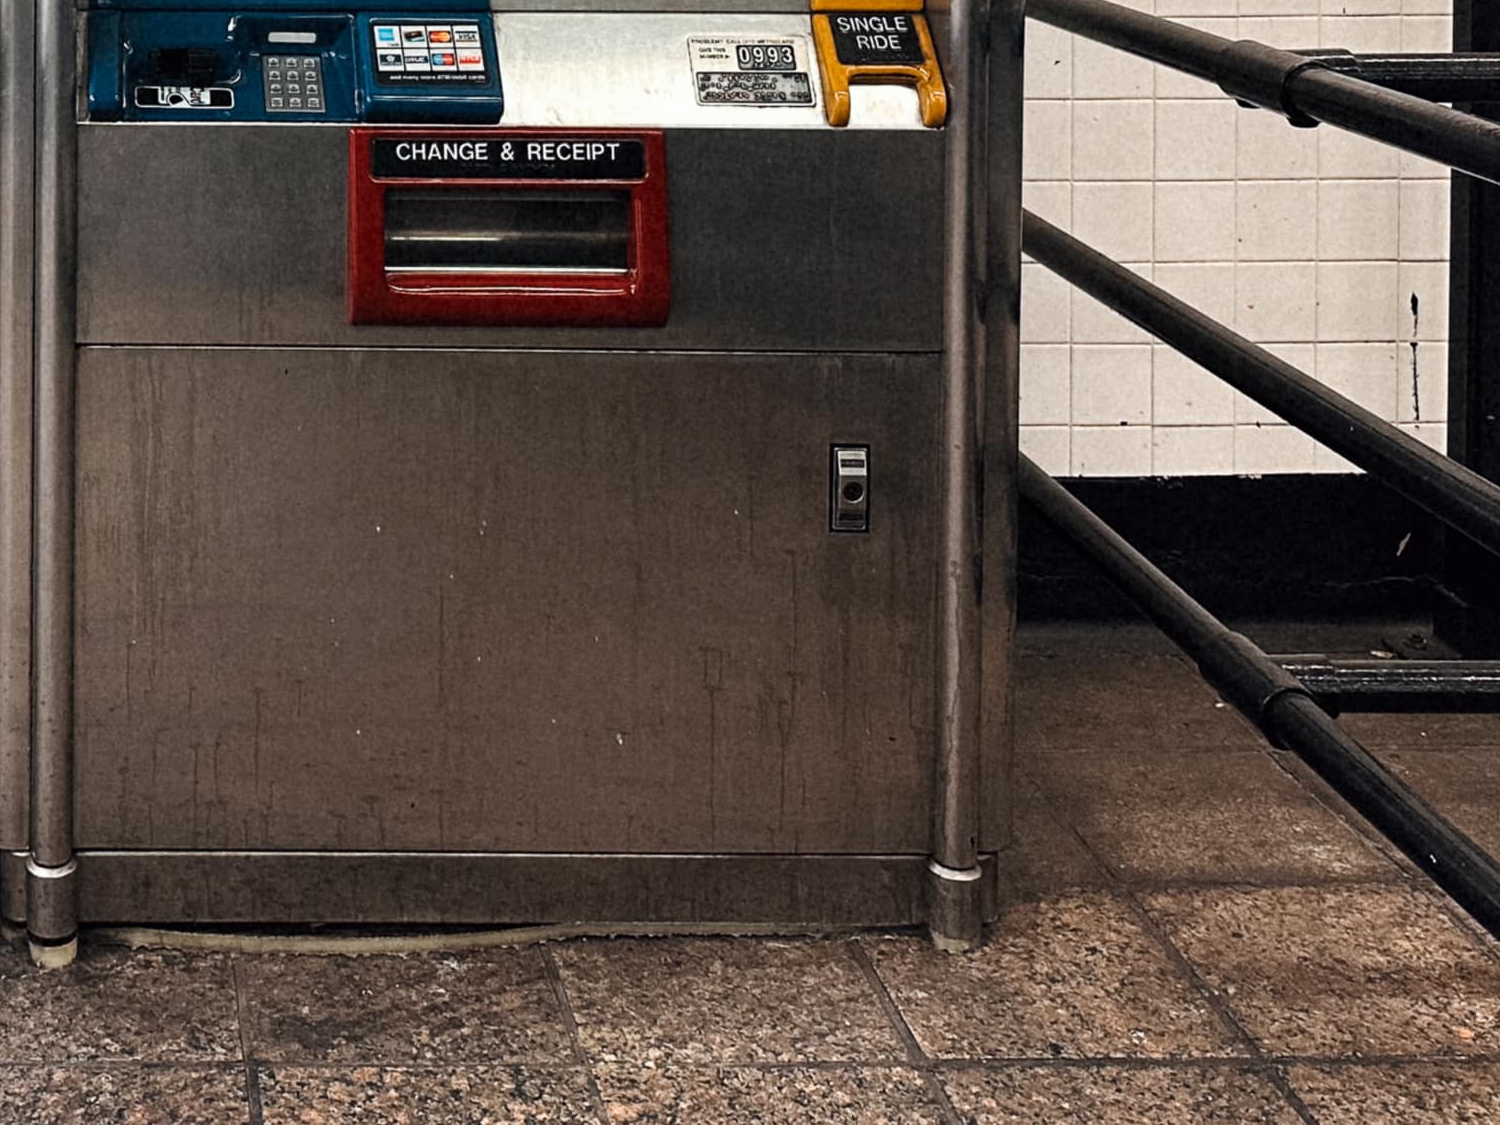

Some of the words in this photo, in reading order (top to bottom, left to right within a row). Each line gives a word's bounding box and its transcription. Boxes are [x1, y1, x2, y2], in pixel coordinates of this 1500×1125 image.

[837, 16, 908, 32] SINGLE
[856, 35, 902, 50] RIDE
[738, 47, 793, 63] 0993
[396, 143, 488, 161] CHANGE
[500, 143, 515, 161] &
[527, 143, 620, 161] RECEIPT
